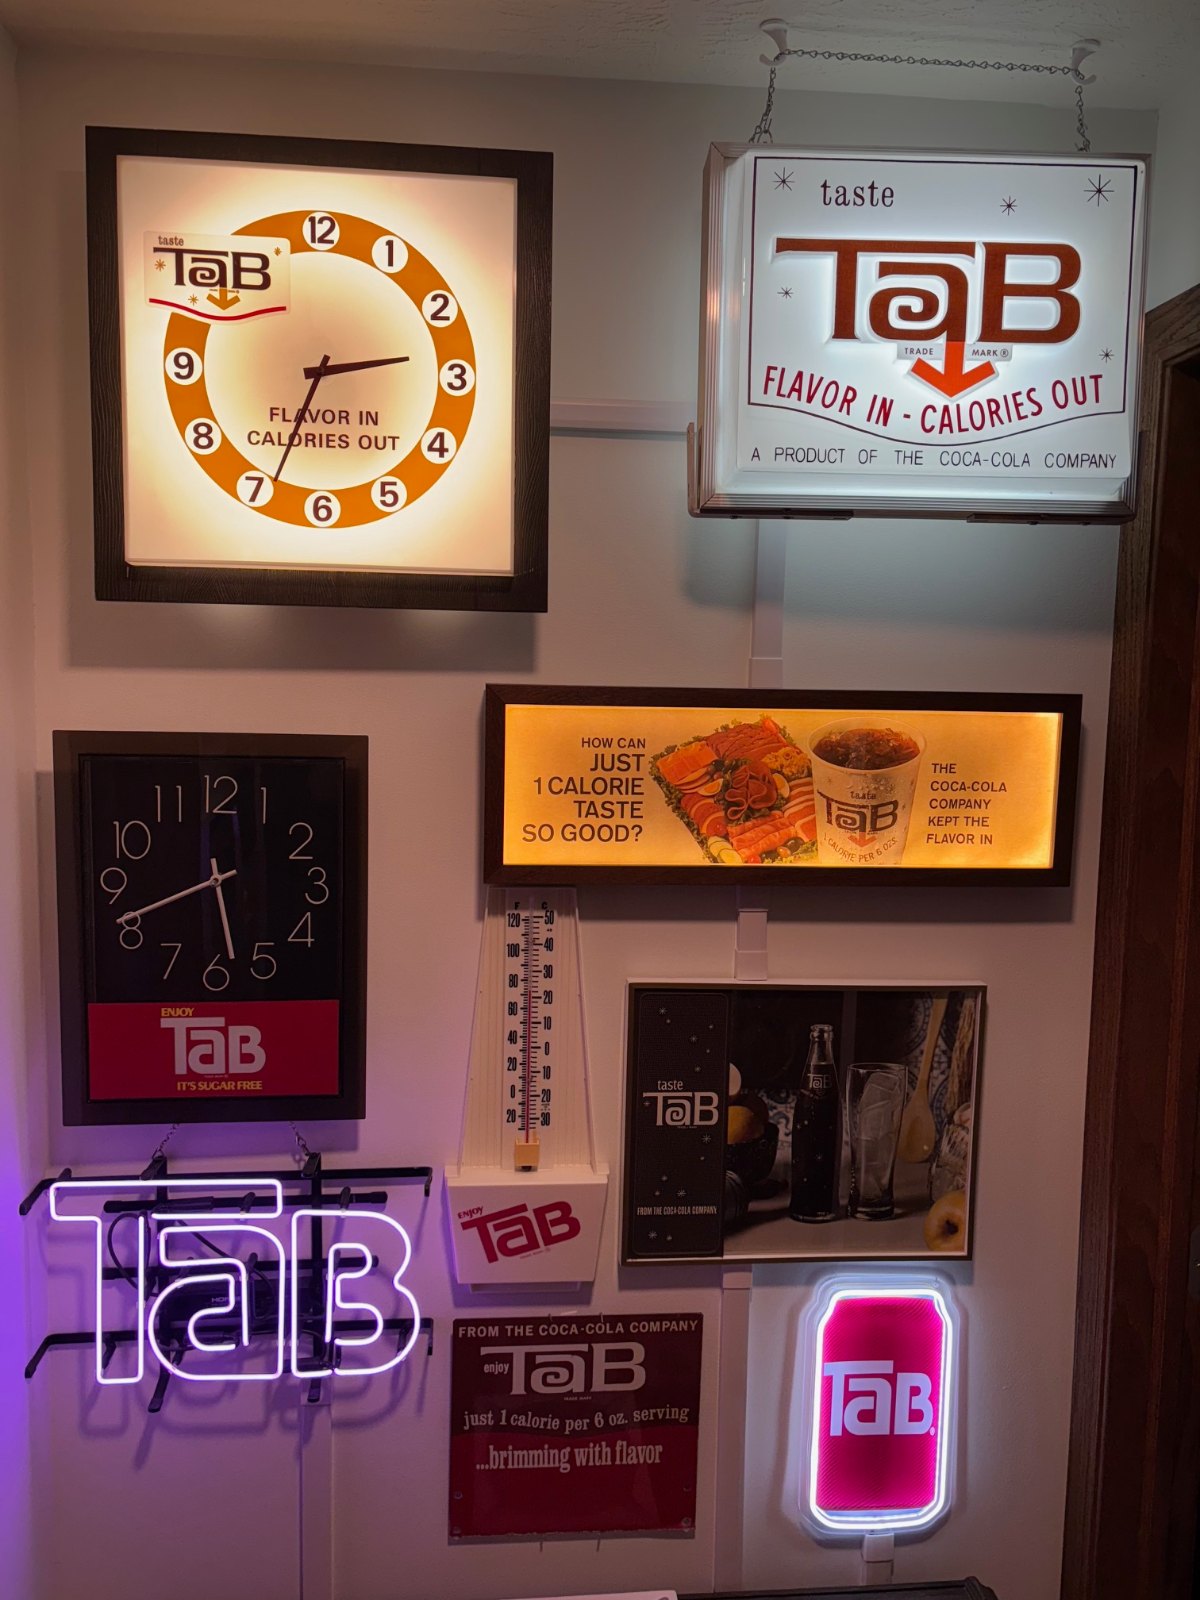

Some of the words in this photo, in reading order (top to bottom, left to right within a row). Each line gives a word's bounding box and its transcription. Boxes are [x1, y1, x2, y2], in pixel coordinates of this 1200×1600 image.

[821, 179, 894, 207] taste
[307, 216, 337, 245] 12
[158, 235, 185, 246] taste
[386, 240, 394, 267] 1
[430, 294, 450, 322] 2
[904, 347, 934, 355] TRADE
[173, 352, 195, 380] 9
[447, 364, 467, 391] 3
[763, 365, 857, 415] FLAVOR
[866, 395, 894, 427] IN
[920, 387, 1043, 434] CALORIES
[1052, 374, 1103, 408] OUT
[269, 407, 350, 426] FLAVOR
[358, 410, 379, 426] IN
[193, 422, 213, 450] 8
[247, 430, 350, 450] CALORIES
[358, 435, 400, 451] OUT
[427, 432, 448, 459] 4
[751, 448, 761, 462] A
[774, 447, 845, 464] PRODUCT
[858, 448, 879, 465] OF
[895, 449, 924, 466] THE
[940, 450, 1031, 468] COCA-COLA
[1044, 452, 1116, 469] COMPANY
[245, 477, 264, 503] 7
[380, 481, 399, 508] 5
[313, 496, 333, 522] 6
[581, 737, 613, 749] HOW
[617, 738, 646, 749] CAN
[590, 753, 645, 772] JUST
[932, 763, 957, 774] THE
[204, 774, 238, 814] 12
[533, 777, 542, 795] 1
[548, 776, 644, 796] CALORIE
[930, 781, 1007, 793] COCA-COLA
[155, 785, 182, 823] 11
[261, 786, 267, 824] 1
[573, 801, 644, 819] TASTE
[929, 799, 992, 810] COMPANY
[928, 816, 961, 827] KEPT
[964, 816, 989, 827] THE
[113, 820, 151, 860] 10
[289, 822, 313, 860] 2
[522, 823, 554, 842] SO
[561, 824, 643, 843] GOOD?
[926, 833, 975, 845] FLAVOR
[980, 834, 993, 845] IN
[859, 853, 875, 863] PER
[876, 848, 883, 856] 6
[100, 867, 127, 905] 9
[305, 866, 329, 905] 3
[514, 902, 520, 910] F
[507, 913, 520, 927] 120
[544, 910, 554, 925] 50
[119, 911, 143, 950] 8
[287, 912, 315, 948] 4
[507, 943, 520, 958] 100
[544, 937, 553, 952] 40
[160, 943, 182, 980] 7
[250, 942, 276, 980] 5
[203, 954, 230, 991] 6
[543, 964, 553, 979] 30
[508, 974, 518, 988] 80
[543, 990, 553, 1004] 20
[161, 1007, 195, 1017] ENJOY
[508, 1001, 518, 1016] 60
[543, 1016, 552, 1030] 10
[507, 1030, 518, 1045] 40
[544, 1041, 550, 1056] 0
[507, 1057, 517, 1071] 20
[542, 1065, 551, 1080] 10
[177, 1081, 196, 1091] IT'S
[198, 1080, 235, 1091] SUGAR
[237, 1080, 263, 1090] FREE
[510, 1084, 516, 1098] 0
[657, 1079, 683, 1091] taste
[541, 1089, 551, 1103] 20
[506, 1109, 516, 1123] 20
[540, 1112, 550, 1126] 30
[457, 1205, 484, 1219] ENJOY
[637, 1206, 652, 1216] FROM
[653, 1206, 663, 1216] THE
[692, 1205, 717, 1215] COMPANY
[459, 1326, 500, 1338] FROM
[505, 1324, 534, 1337] THE
[539, 1322, 625, 1336] COCA-COLA
[629, 1320, 698, 1334] COMPANY
[483, 1361, 510, 1375] enjoy
[463, 1409, 494, 1430] just
[499, 1410, 507, 1425] 1
[510, 1411, 560, 1430] calorie
[564, 1419, 590, 1434] per
[594, 1412, 604, 1428] 6
[609, 1415, 628, 1427] oz.
[633, 1404, 690, 1423] serving
[574, 1442, 612, 1467] with
[614, 1440, 663, 1465] flavor
